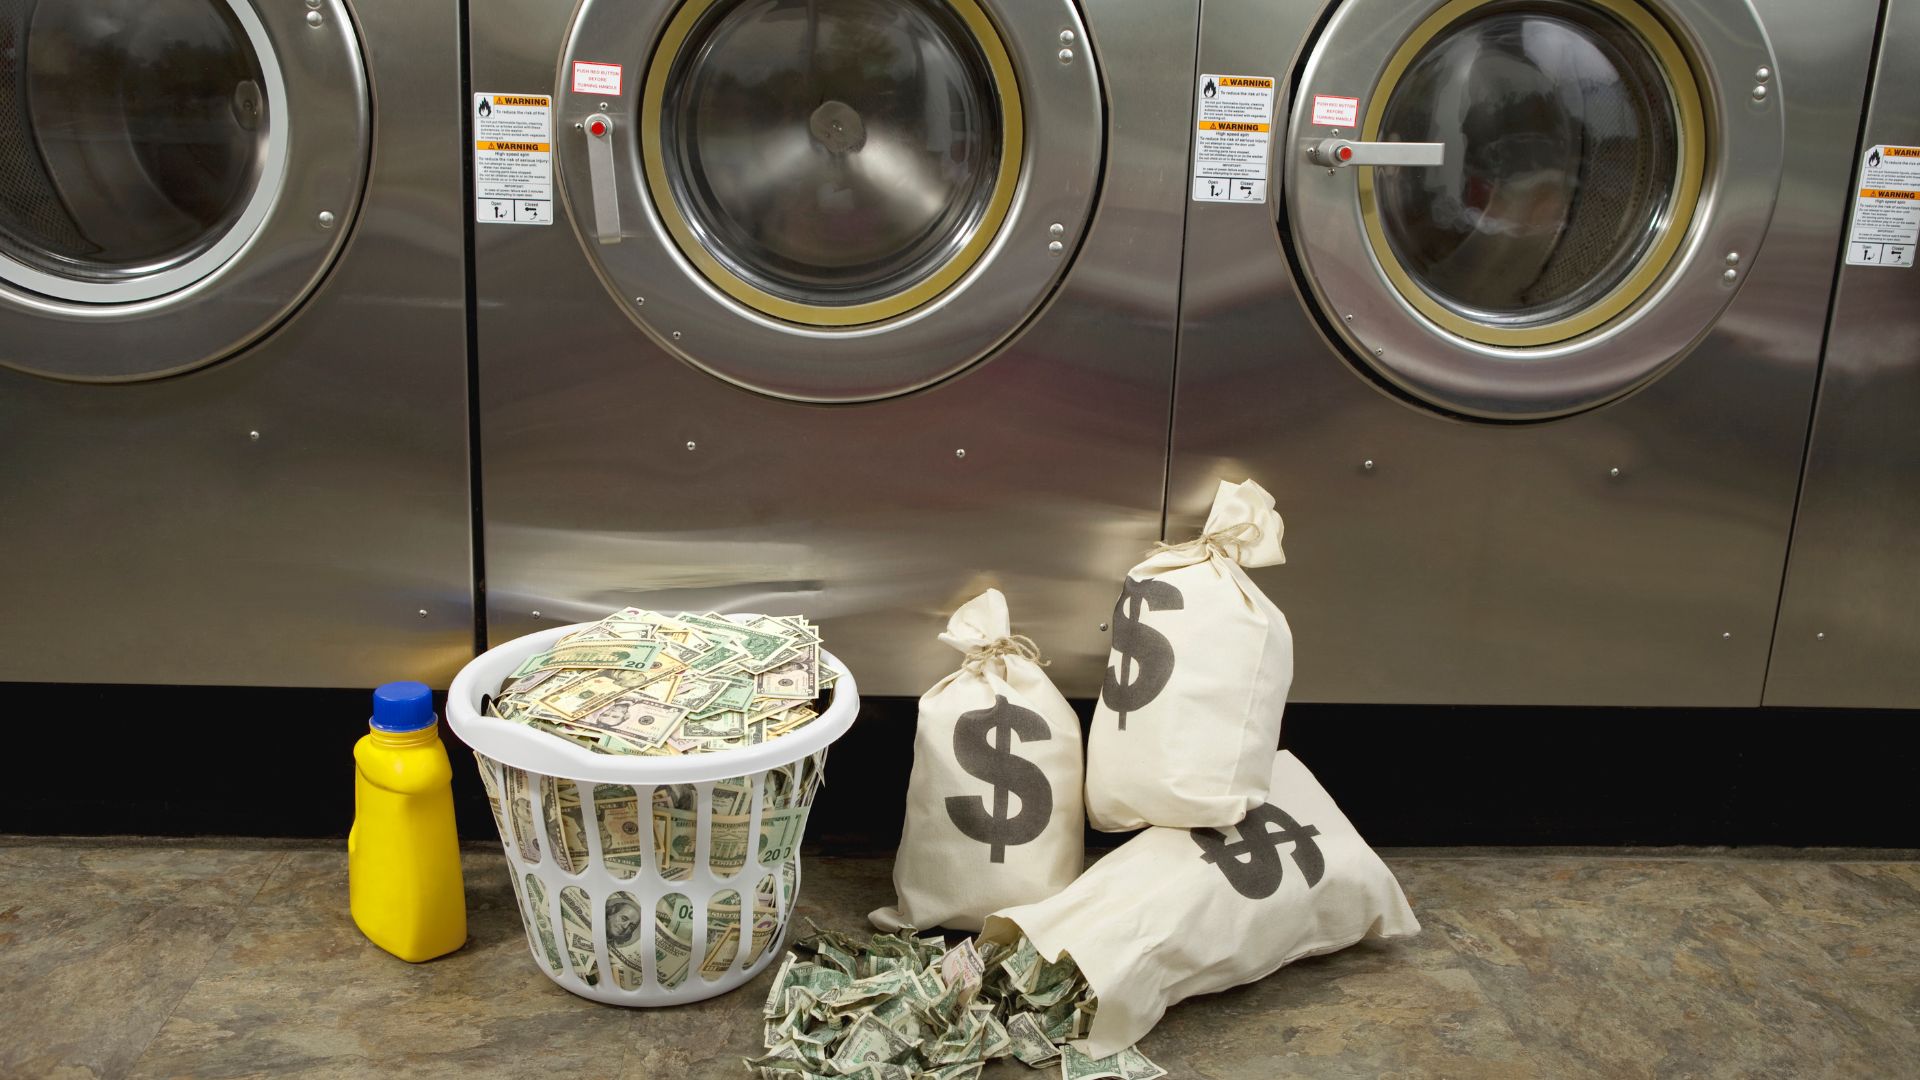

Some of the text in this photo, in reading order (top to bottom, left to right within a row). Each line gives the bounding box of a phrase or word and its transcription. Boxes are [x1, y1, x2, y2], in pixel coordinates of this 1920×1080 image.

[1230, 78, 1270, 86] WARNING
[504, 97, 547, 106] WARNING
[496, 142, 538, 151] WARNING
[1878, 191, 1915, 199] WARNING
[1102, 575, 1184, 731] $
[624, 660, 645, 669] 20
[944, 694, 1053, 864] $
[763, 849, 780, 862] 20
